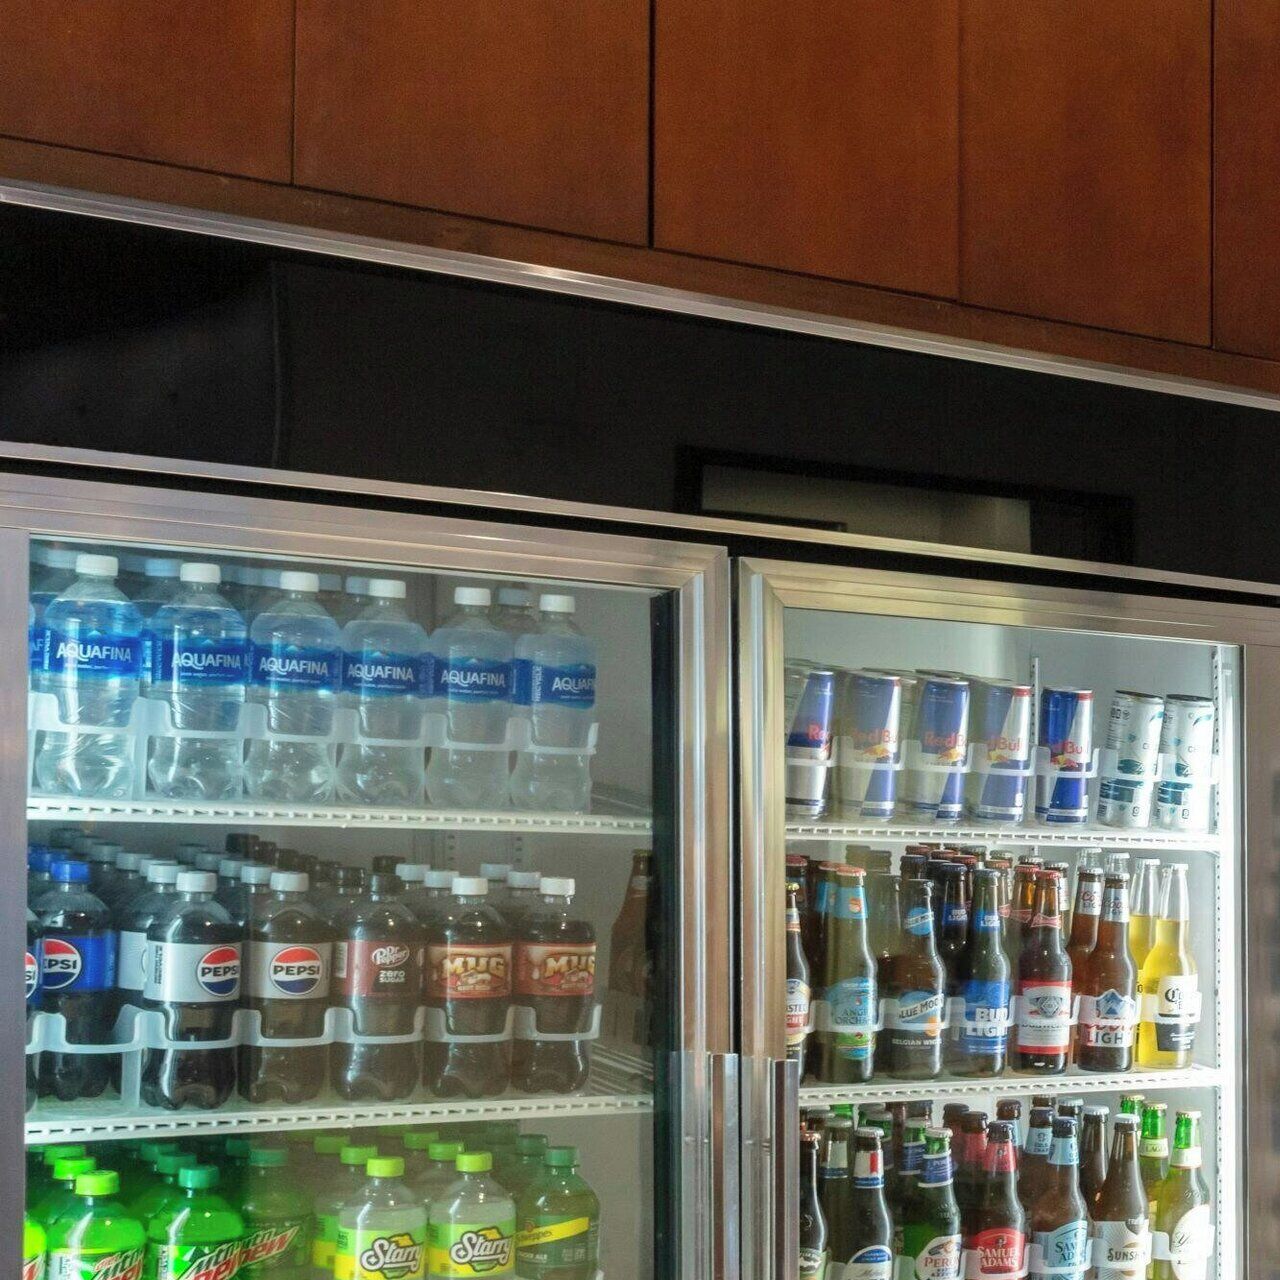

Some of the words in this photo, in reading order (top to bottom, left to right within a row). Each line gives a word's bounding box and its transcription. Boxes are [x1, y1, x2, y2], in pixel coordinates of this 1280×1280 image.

[56, 642, 132, 663] AQUAFINA
[172, 652, 241, 669] AQUAFINA
[259, 657, 328, 676] AQUAFINA
[347, 663, 414, 683] AQUAFINA
[441, 670, 506, 687] AQUAFINA
[43, 958, 77, 970] EPSI
[371, 950, 410, 967] Pepper
[441, 956, 504, 975] MUG
[273, 964, 321, 978] PEPSI
[379, 970, 405, 978] zero
[450, 1233, 513, 1265] Starry
